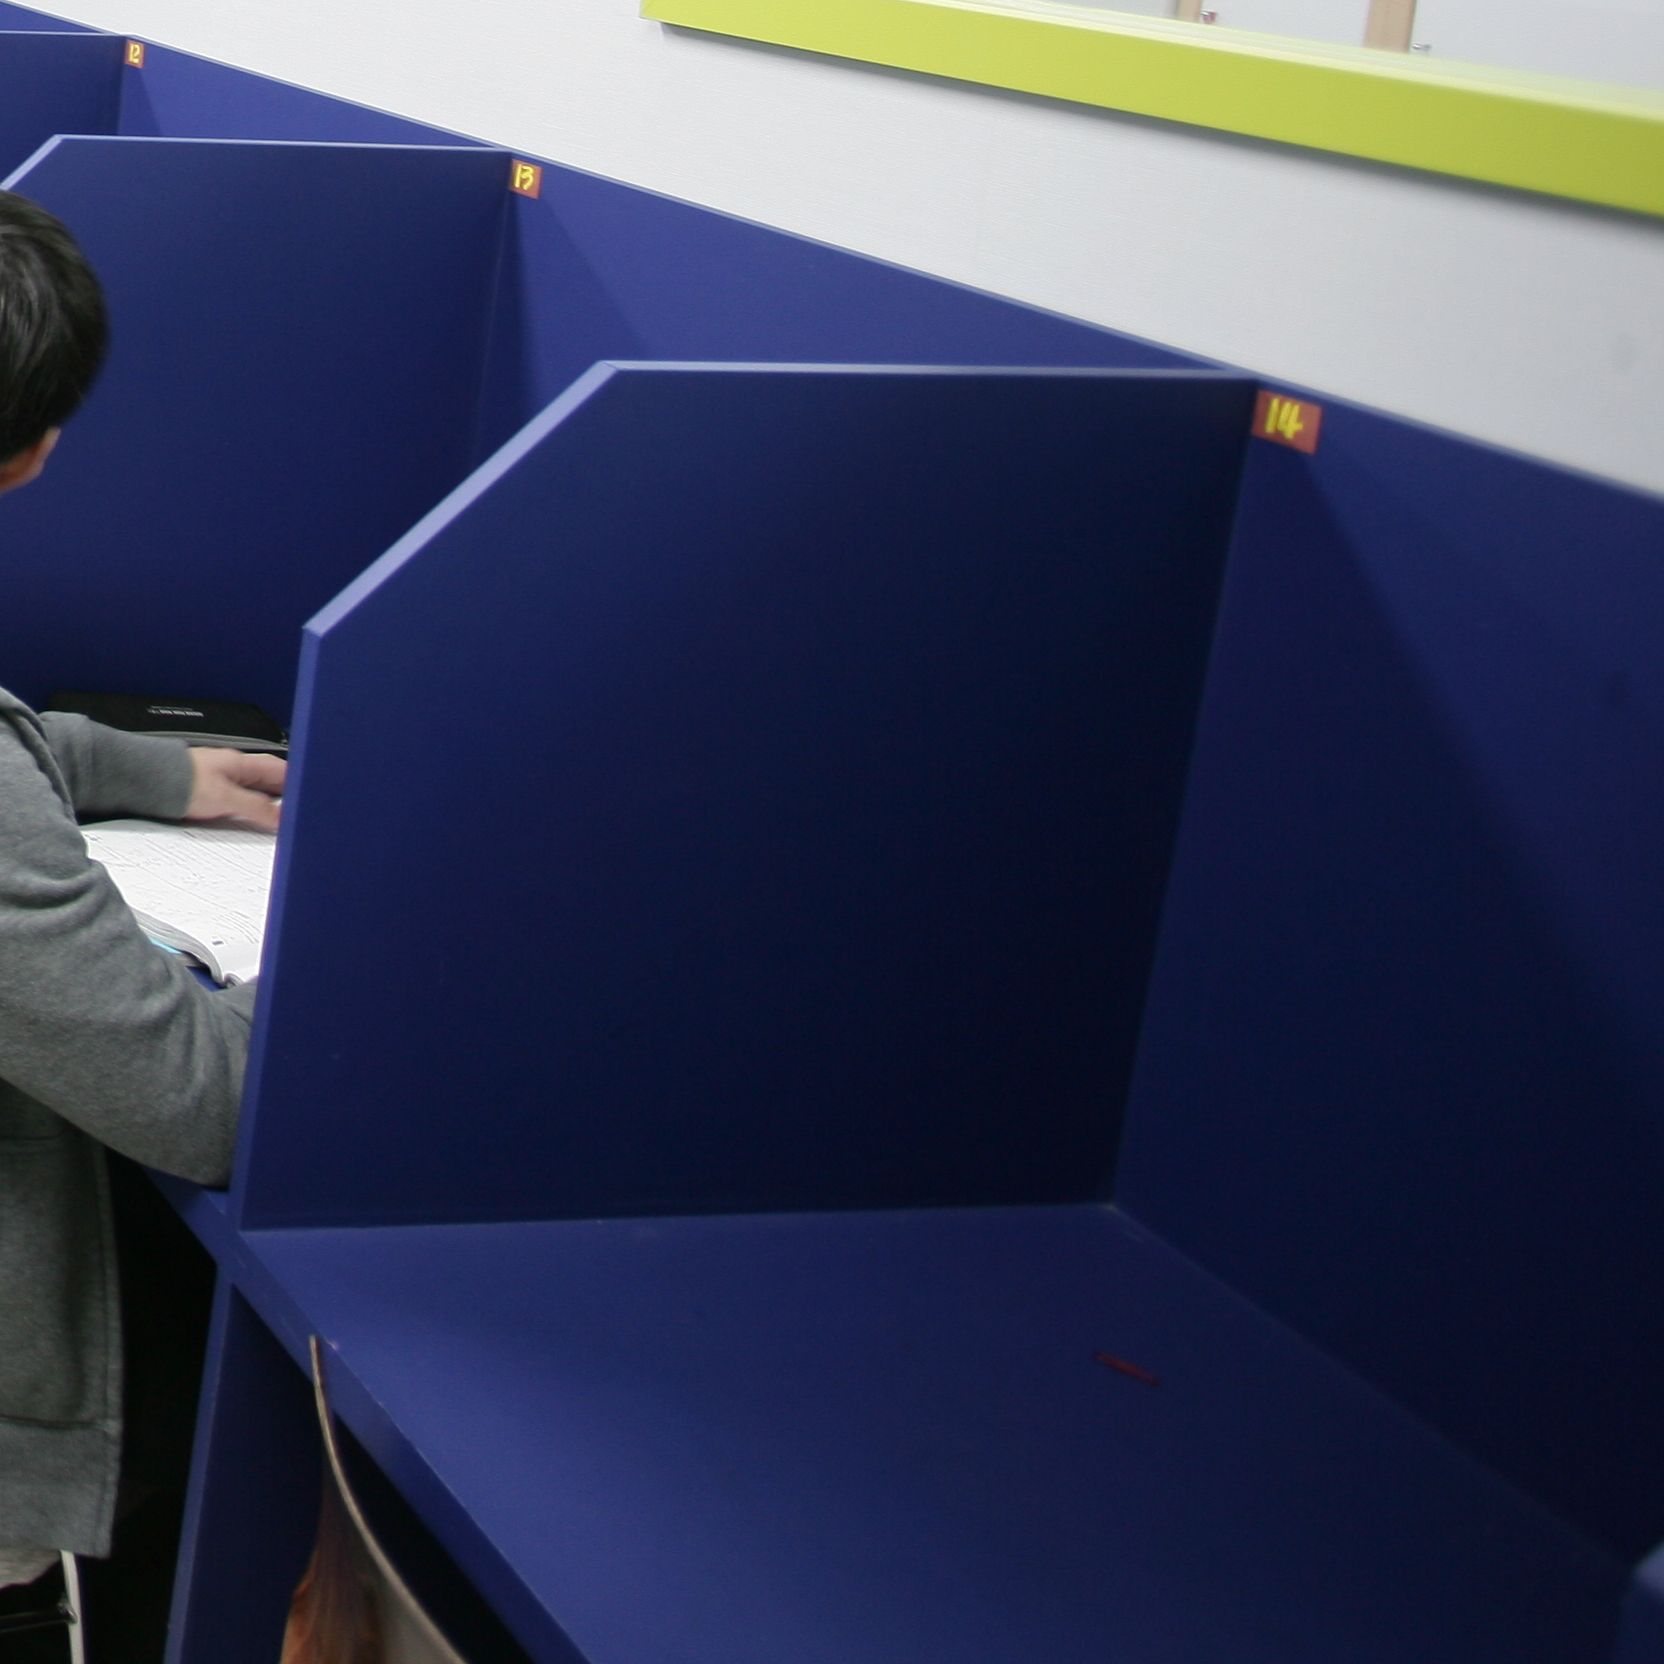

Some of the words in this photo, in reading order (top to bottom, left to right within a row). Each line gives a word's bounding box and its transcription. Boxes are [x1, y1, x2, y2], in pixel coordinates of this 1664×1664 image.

[129, 43, 141, 64] 12
[514, 164, 534, 191] 13
[1265, 397, 1304, 440] 14
